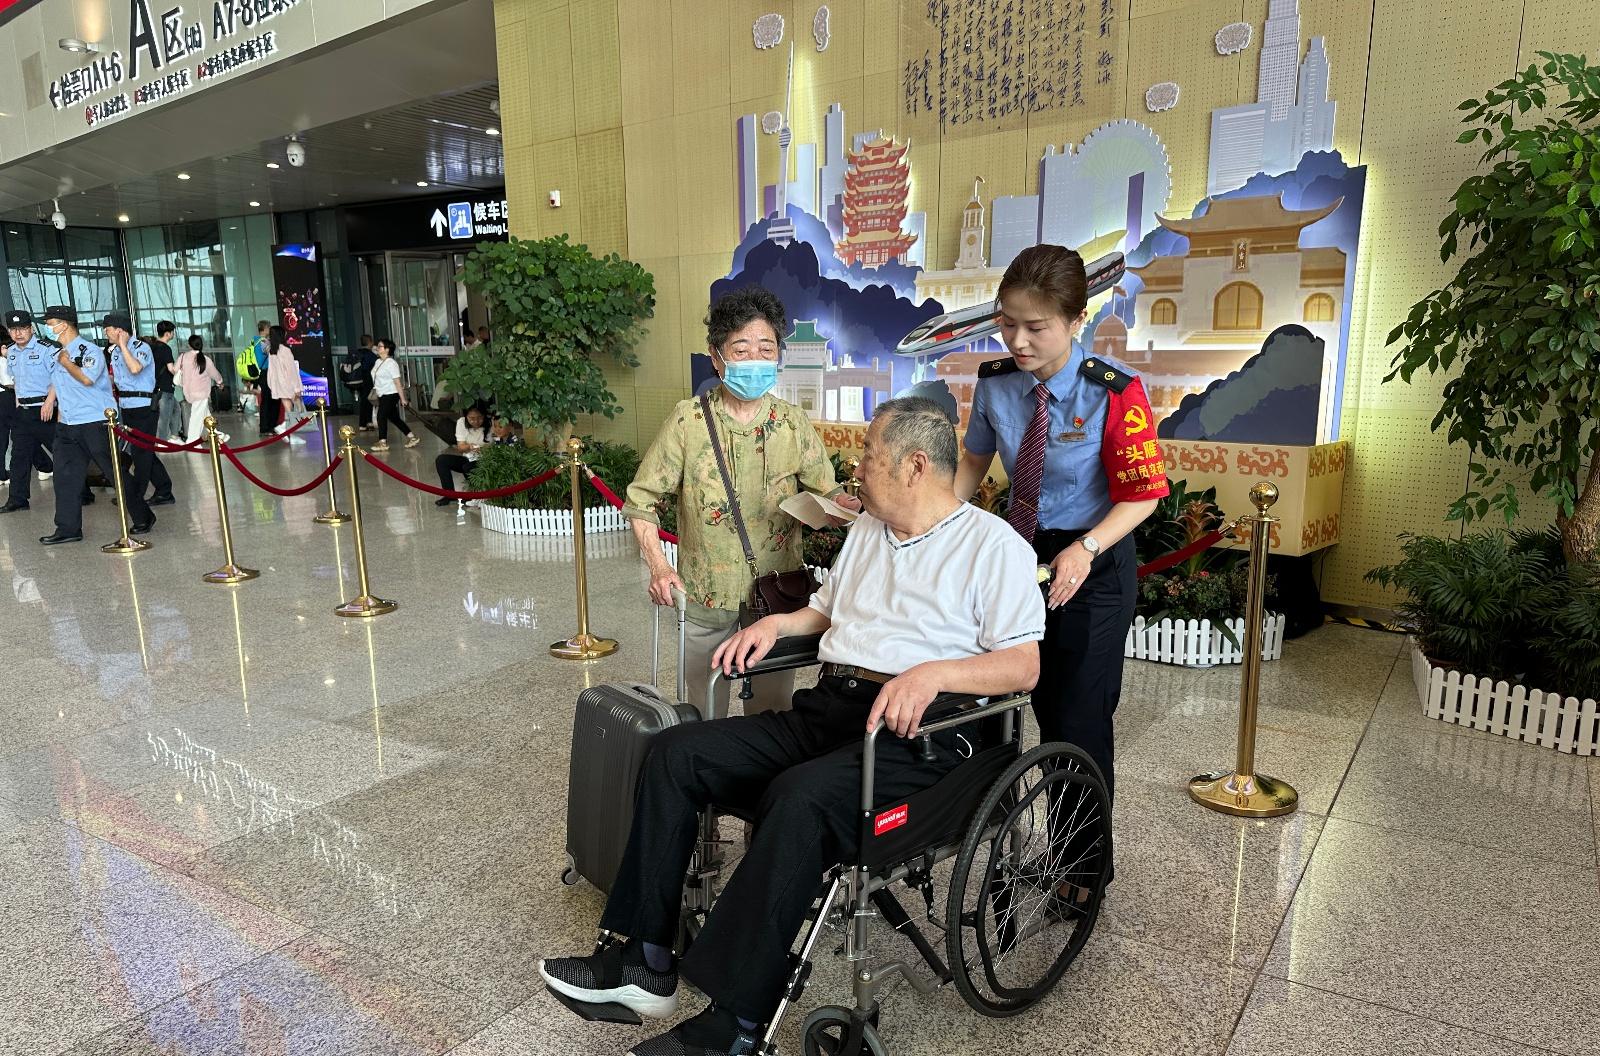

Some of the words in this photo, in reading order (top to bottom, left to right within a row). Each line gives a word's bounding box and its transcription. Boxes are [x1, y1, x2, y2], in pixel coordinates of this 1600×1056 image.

[473, 200, 509, 222] 候车区
[474, 223, 503, 236] Waiting
